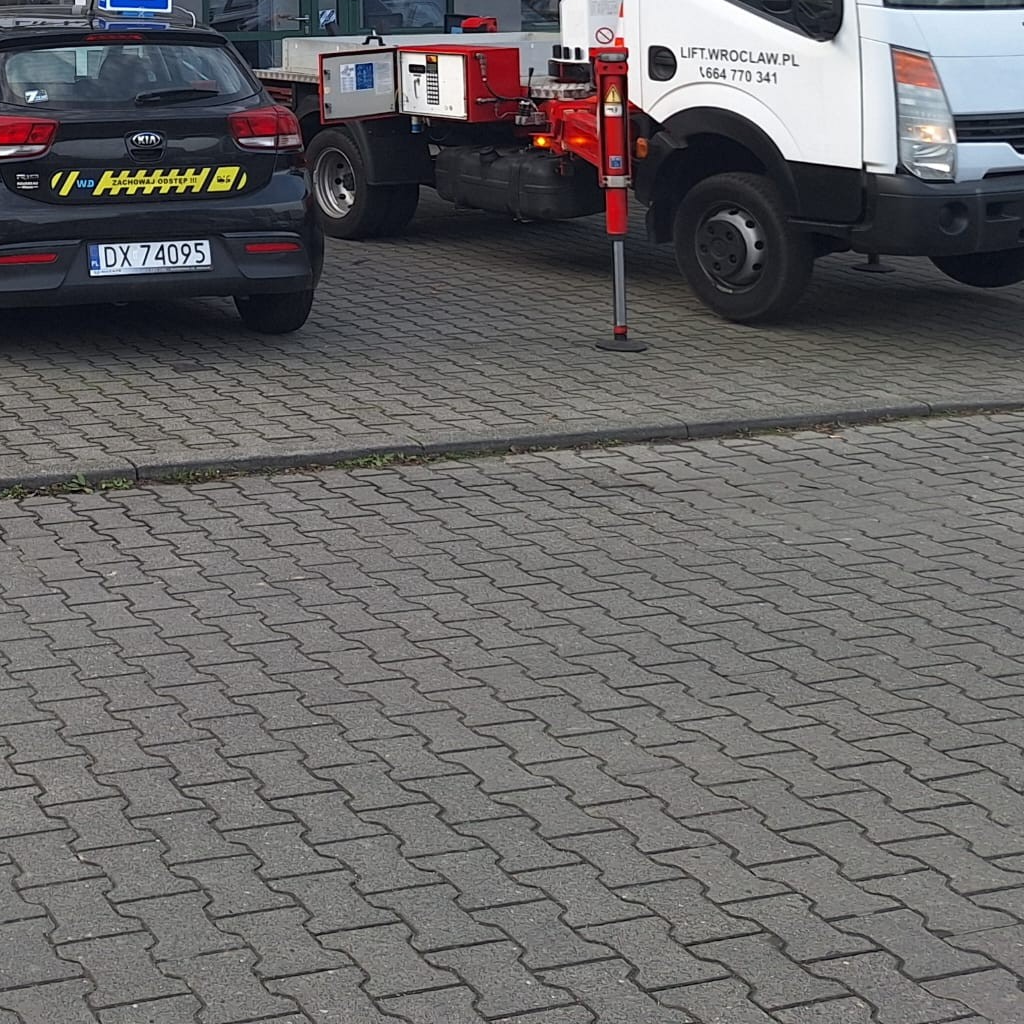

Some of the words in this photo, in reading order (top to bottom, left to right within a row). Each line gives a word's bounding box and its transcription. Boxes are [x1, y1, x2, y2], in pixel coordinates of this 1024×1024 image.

[680, 46, 800, 67] LIFT.WROCLAW.PL
[705, 67, 727, 80] 664
[730, 69, 753, 82] 770
[756, 71, 778, 84] 341
[112, 177, 156, 186] ZACHOWAJ
[104, 245, 132, 268] DX
[140, 242, 206, 266] 74095
